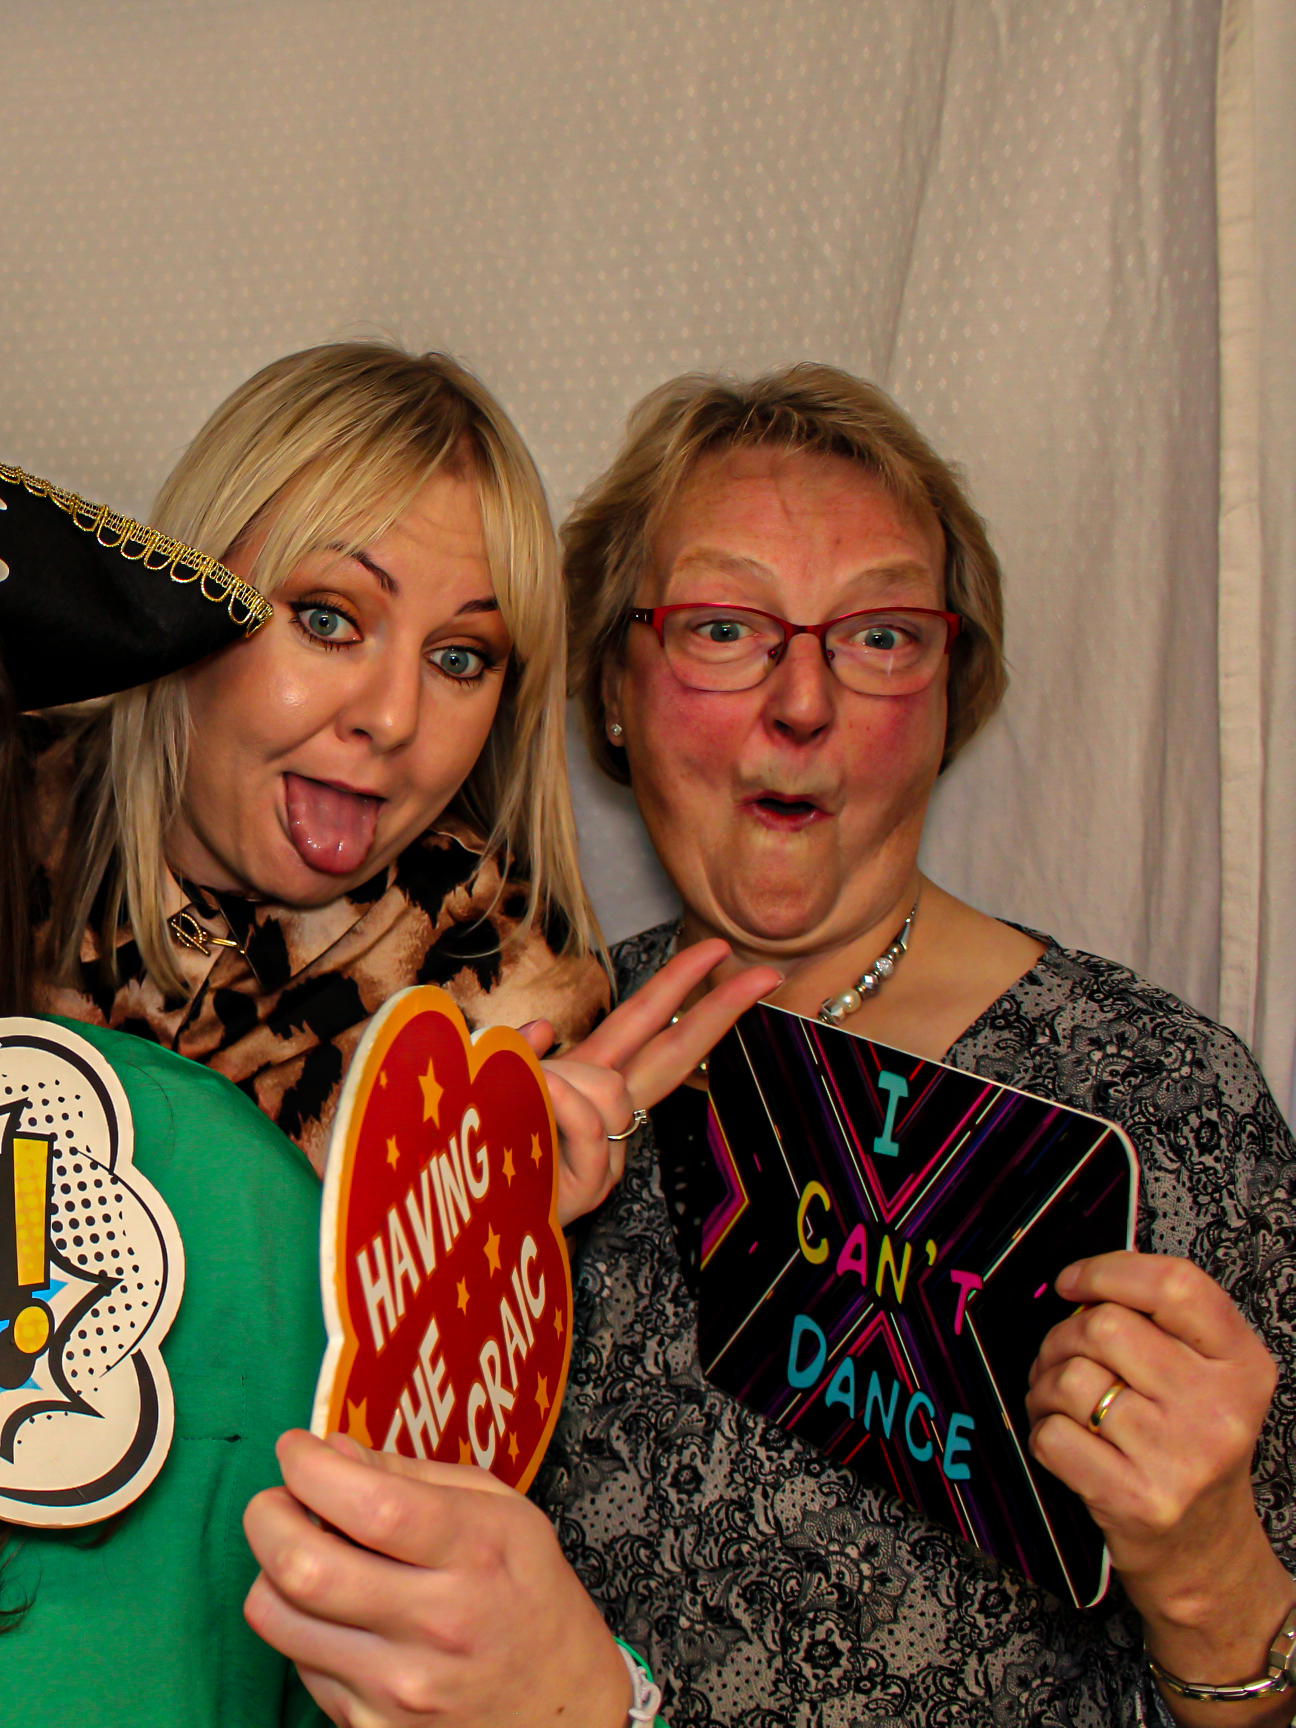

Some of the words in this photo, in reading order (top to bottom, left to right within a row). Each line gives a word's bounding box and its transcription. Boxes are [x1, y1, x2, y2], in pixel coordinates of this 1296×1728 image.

[872, 1069, 909, 1157] I
[355, 1106, 491, 1353] HAVING
[797, 1180, 983, 1335] CAN'T
[467, 1233, 547, 1471] CRAIC
[787, 1314, 975, 1480] DANCE
